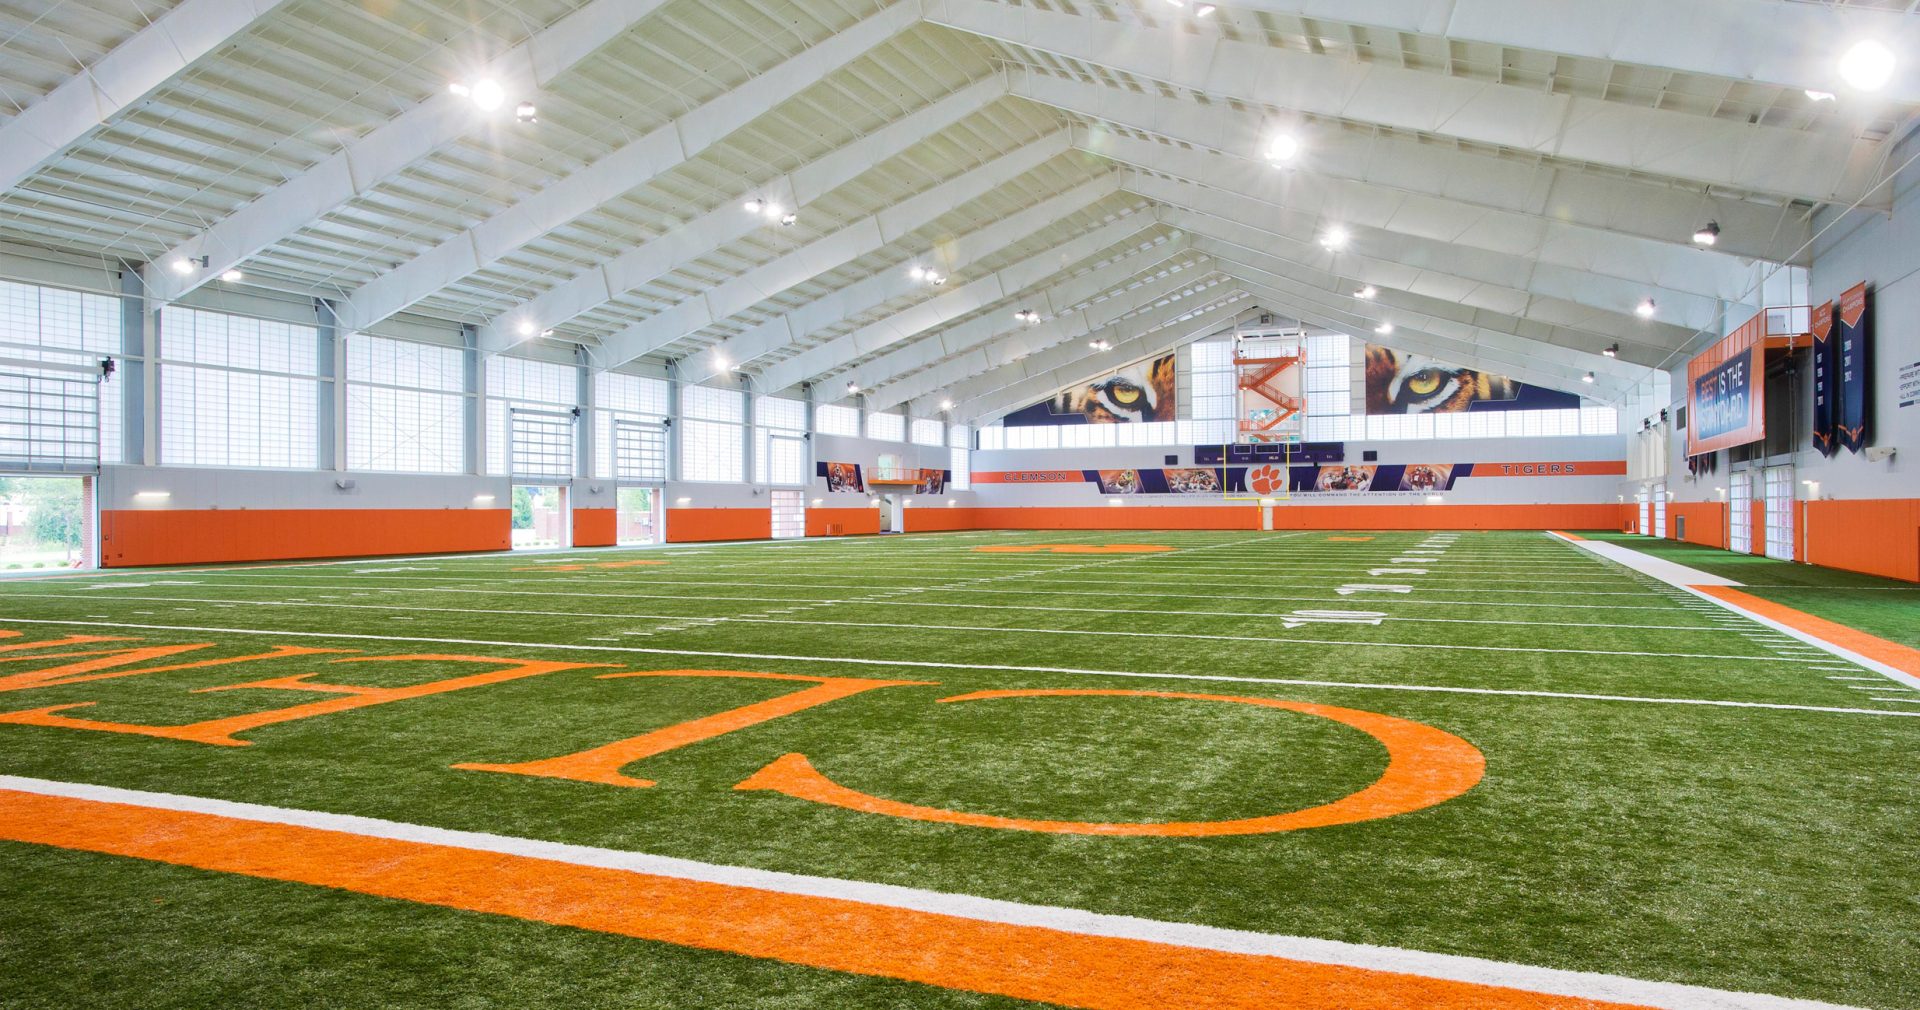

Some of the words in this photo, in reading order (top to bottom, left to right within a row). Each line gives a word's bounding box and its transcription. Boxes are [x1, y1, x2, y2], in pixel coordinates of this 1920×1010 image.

[1718, 371, 1726, 395] IS
[1727, 361, 1743, 390] THE
[1501, 463, 1576, 475] TIGERS
[1004, 471, 1067, 482] CLEMSON
